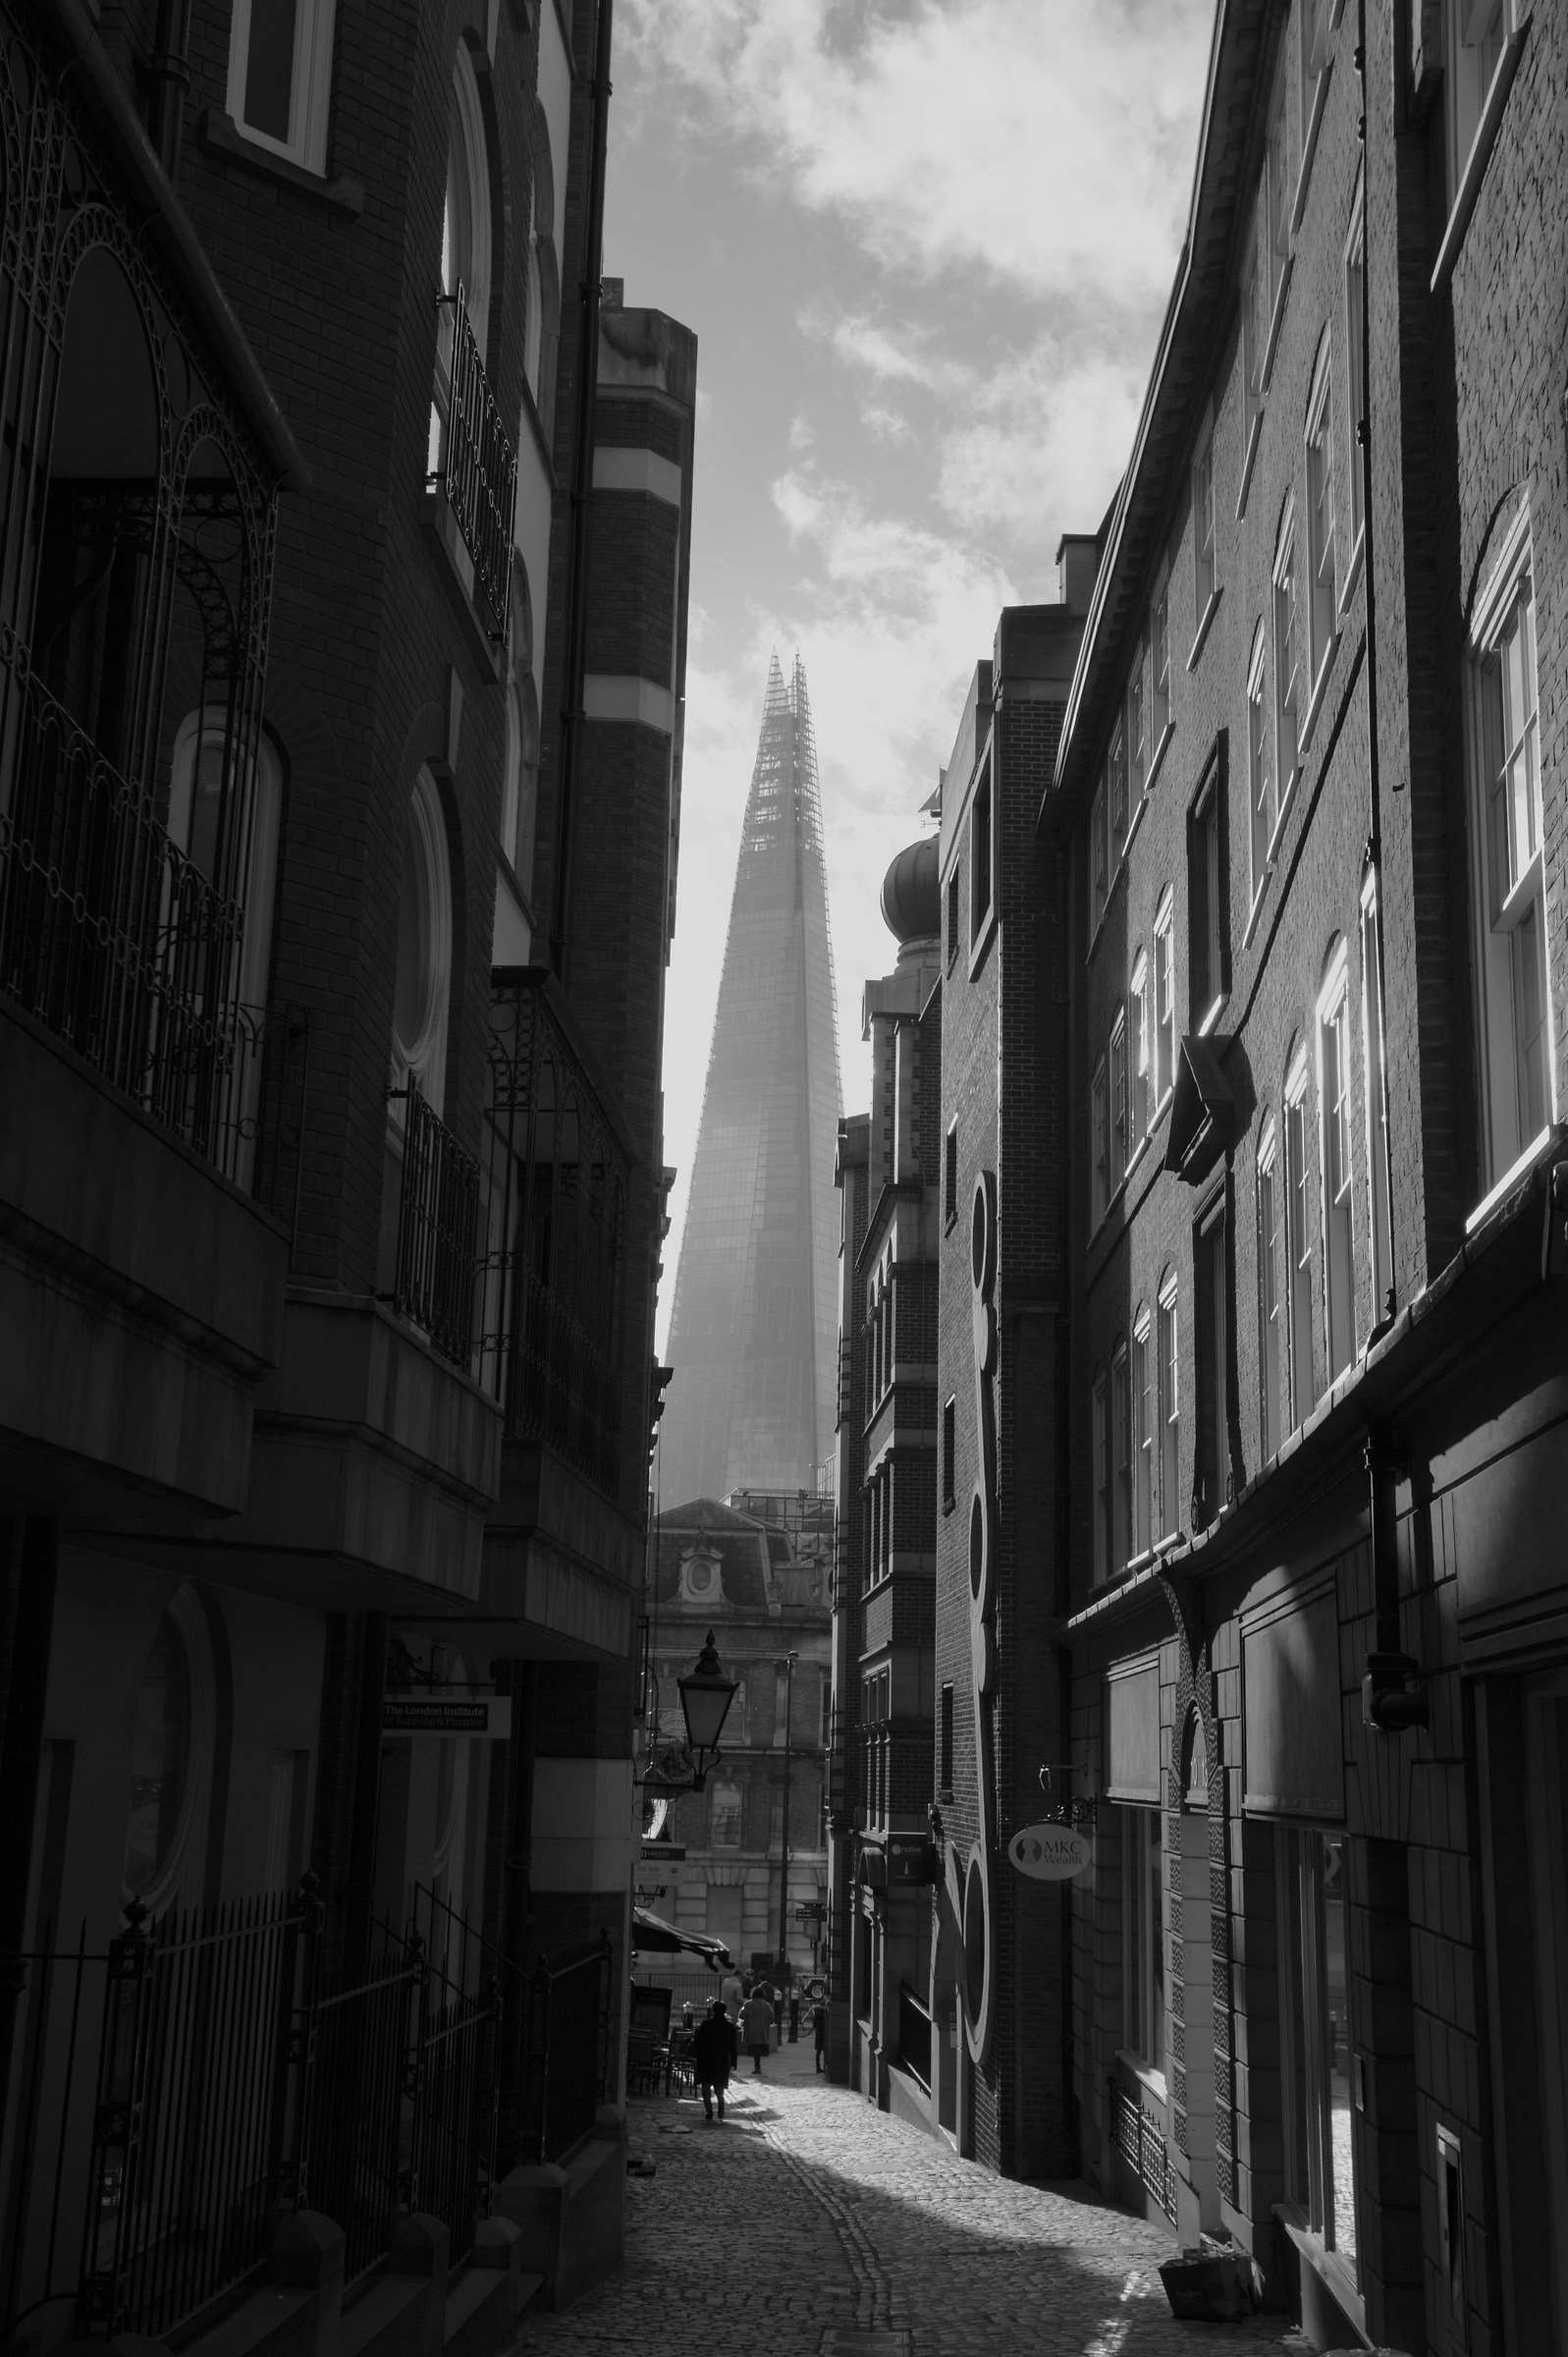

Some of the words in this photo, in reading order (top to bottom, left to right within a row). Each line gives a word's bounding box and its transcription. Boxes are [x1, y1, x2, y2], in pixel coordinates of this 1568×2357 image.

[385, 1705, 404, 1715] The
[405, 1705, 442, 1716] London
[444, 1706, 485, 1717] Institute
[396, 1716, 435, 1727] Banking
[436, 1717, 444, 1726] &
[446, 1717, 486, 1727] Finance
[1044, 1840, 1082, 1854] MKC
[1044, 1853, 1082, 1864] Wealth
